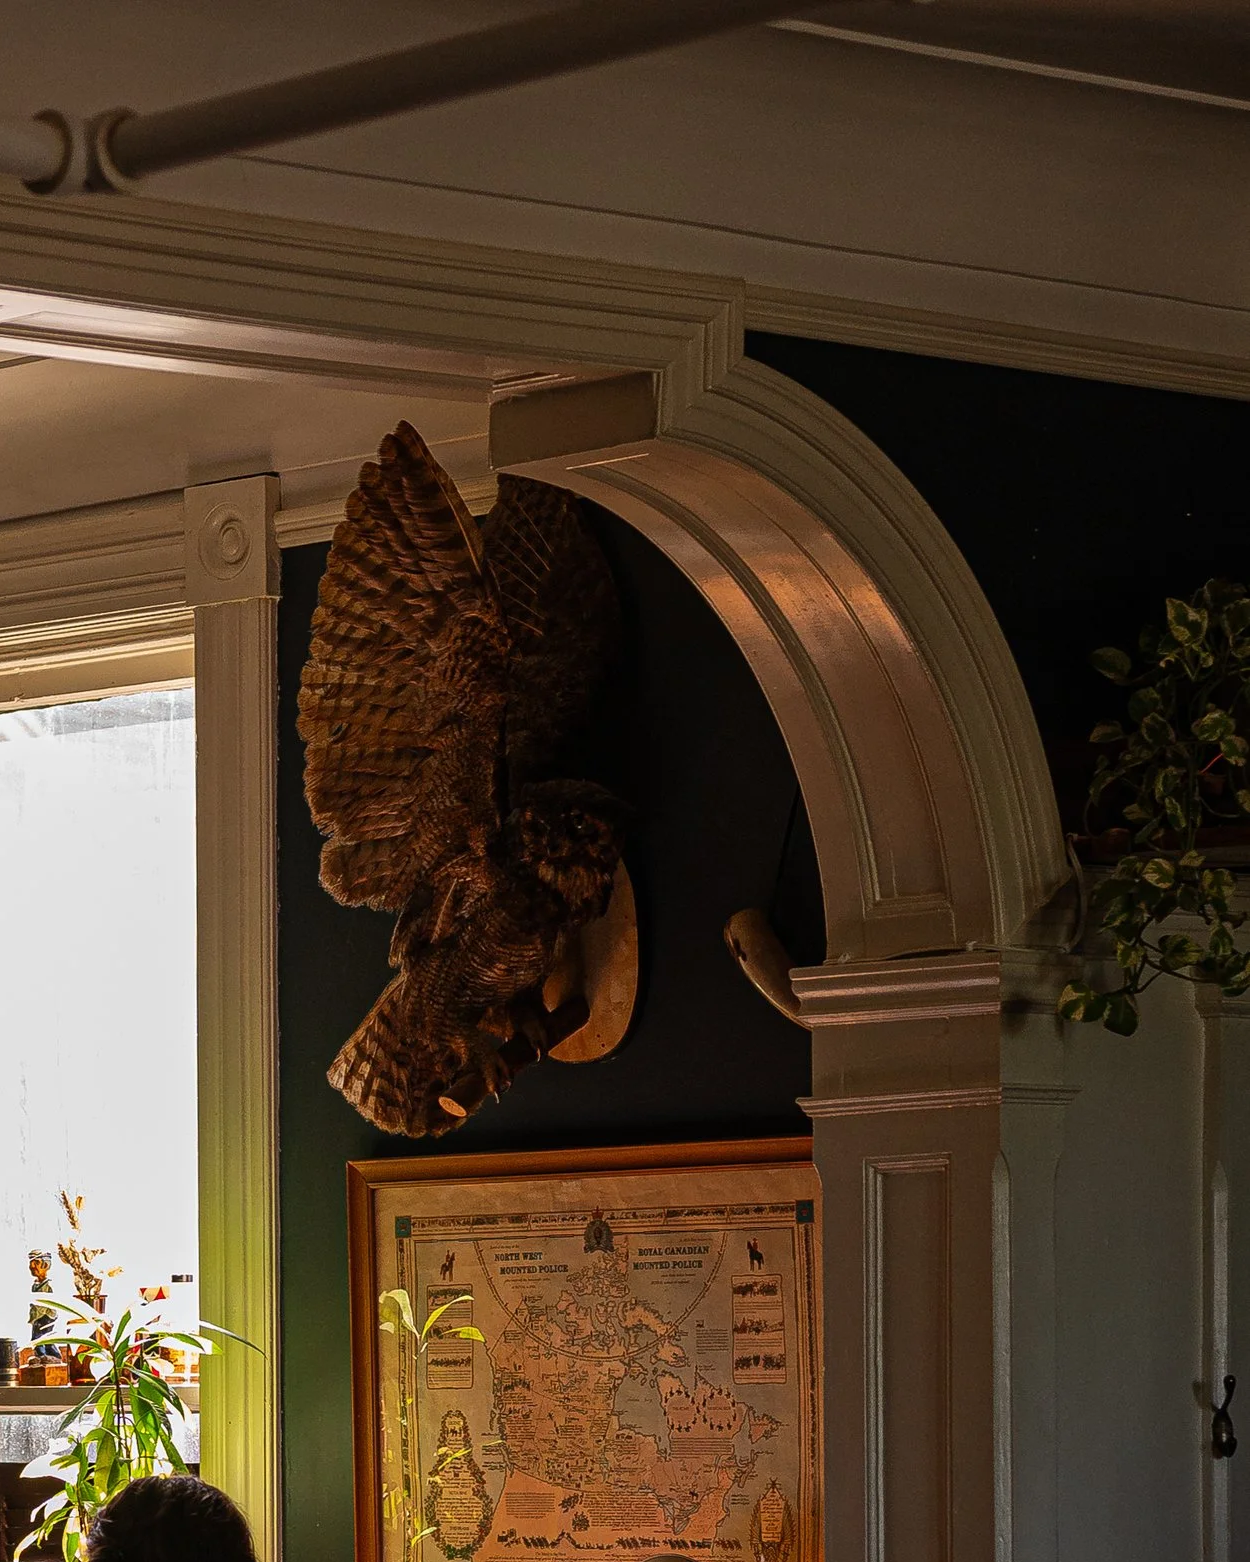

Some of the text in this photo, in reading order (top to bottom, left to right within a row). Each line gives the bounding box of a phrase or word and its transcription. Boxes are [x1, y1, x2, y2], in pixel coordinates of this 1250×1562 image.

[638, 1246, 709, 1256] ROYAL CANADIAN
[494, 1252, 543, 1261] NORTH WEST
[500, 1265, 568, 1274] MOUNTED POLICE
[633, 1260, 702, 1270] MOUNTED POLICE
